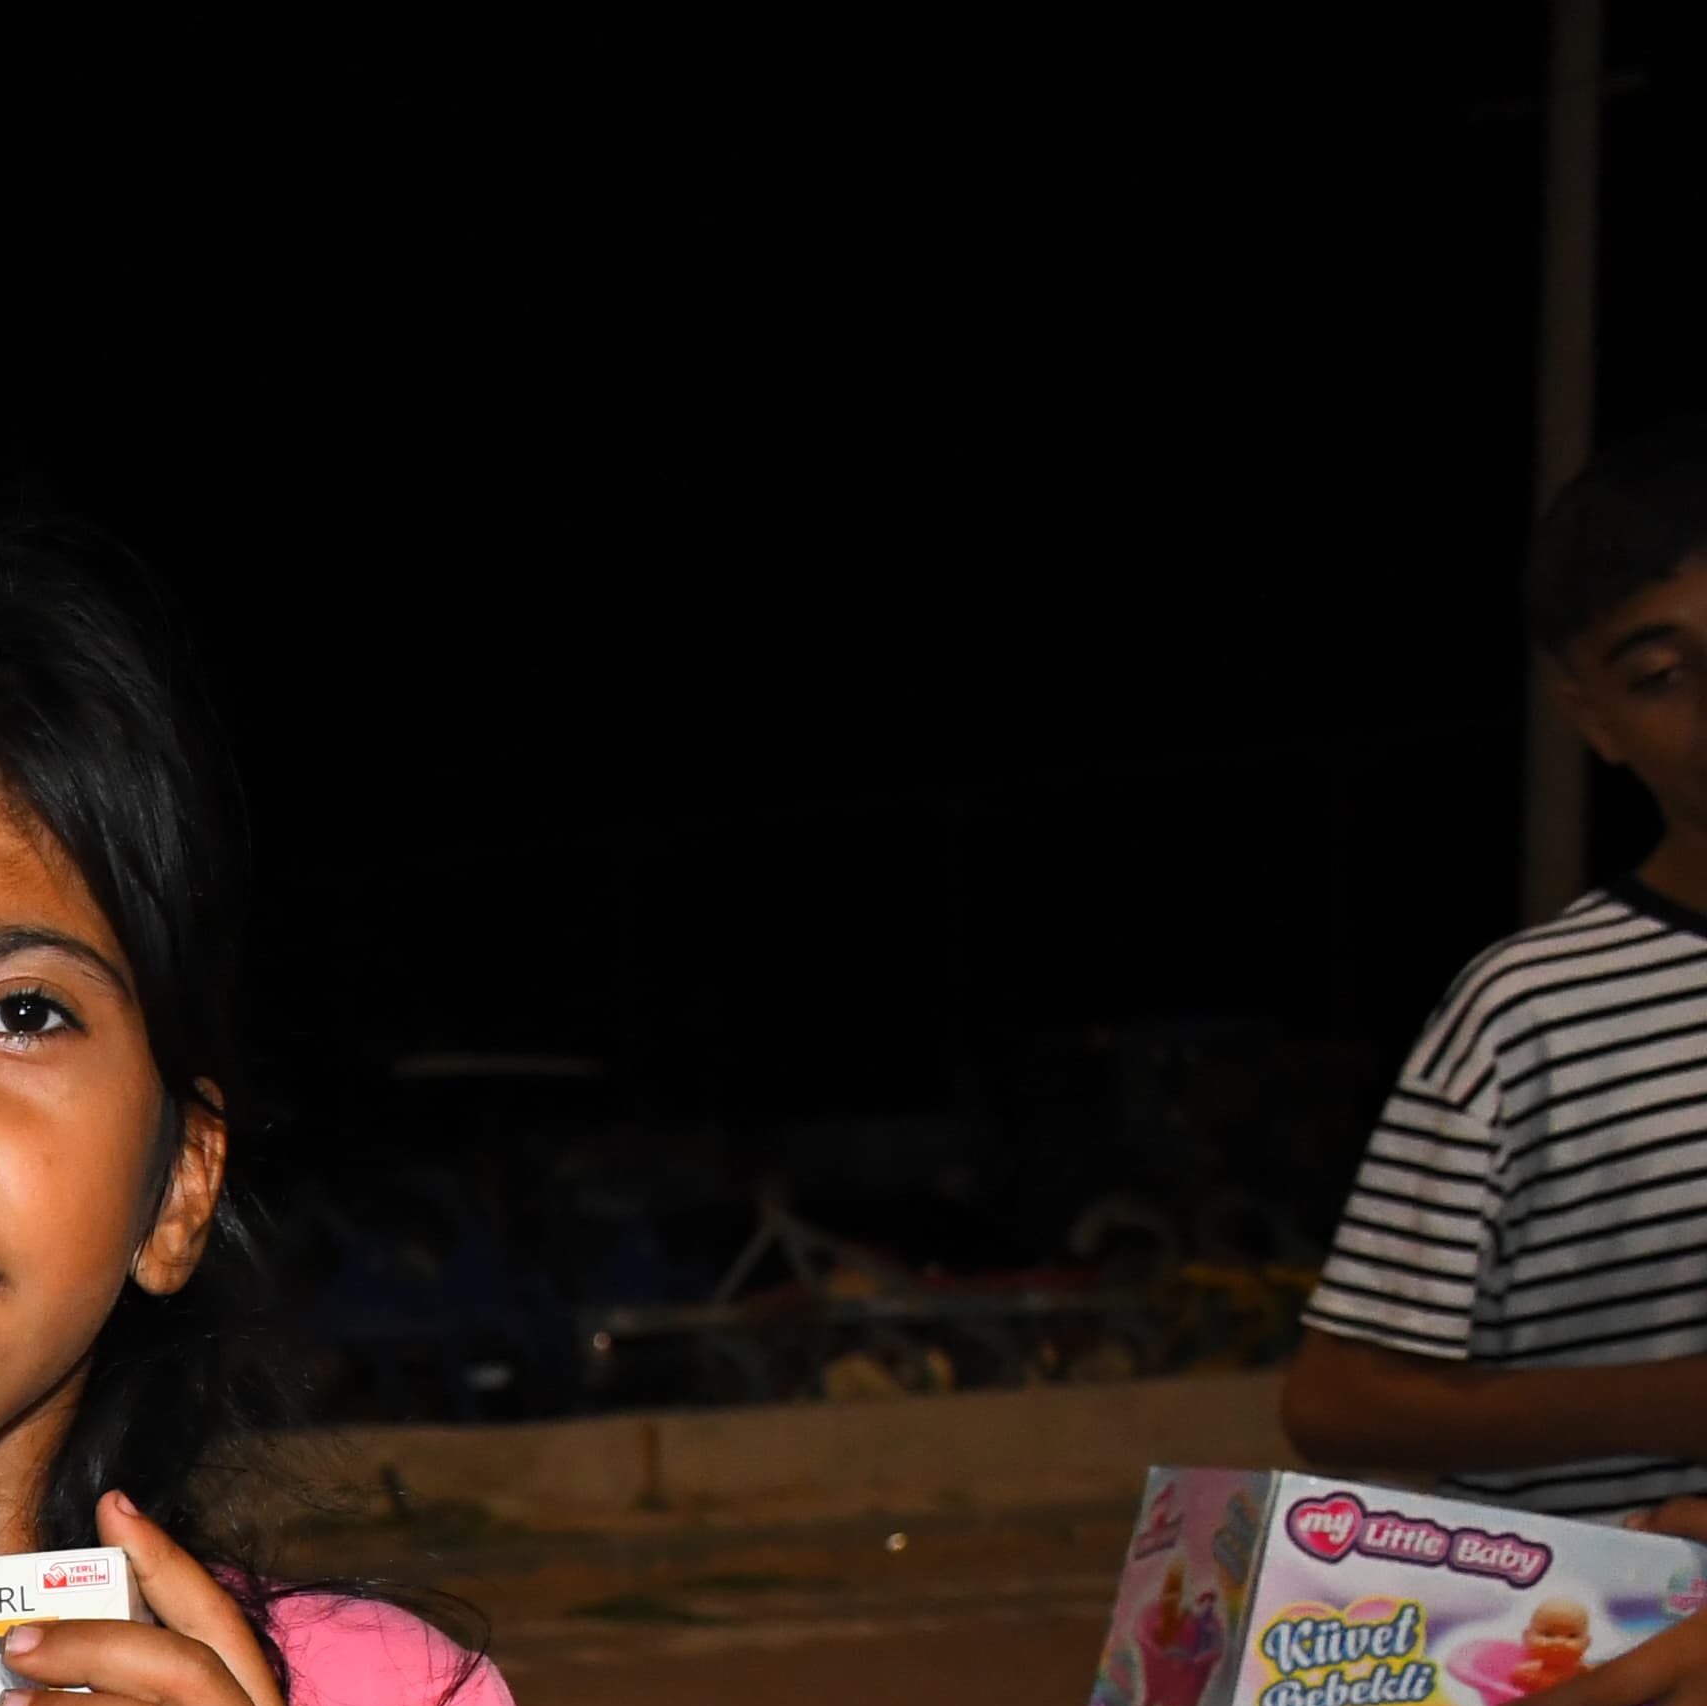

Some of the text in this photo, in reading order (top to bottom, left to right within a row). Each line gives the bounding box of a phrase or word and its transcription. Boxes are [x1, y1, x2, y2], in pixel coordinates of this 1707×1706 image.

[1297, 1509, 1541, 1577] my Little Baby
[1263, 1604, 1420, 1675] Küvet
